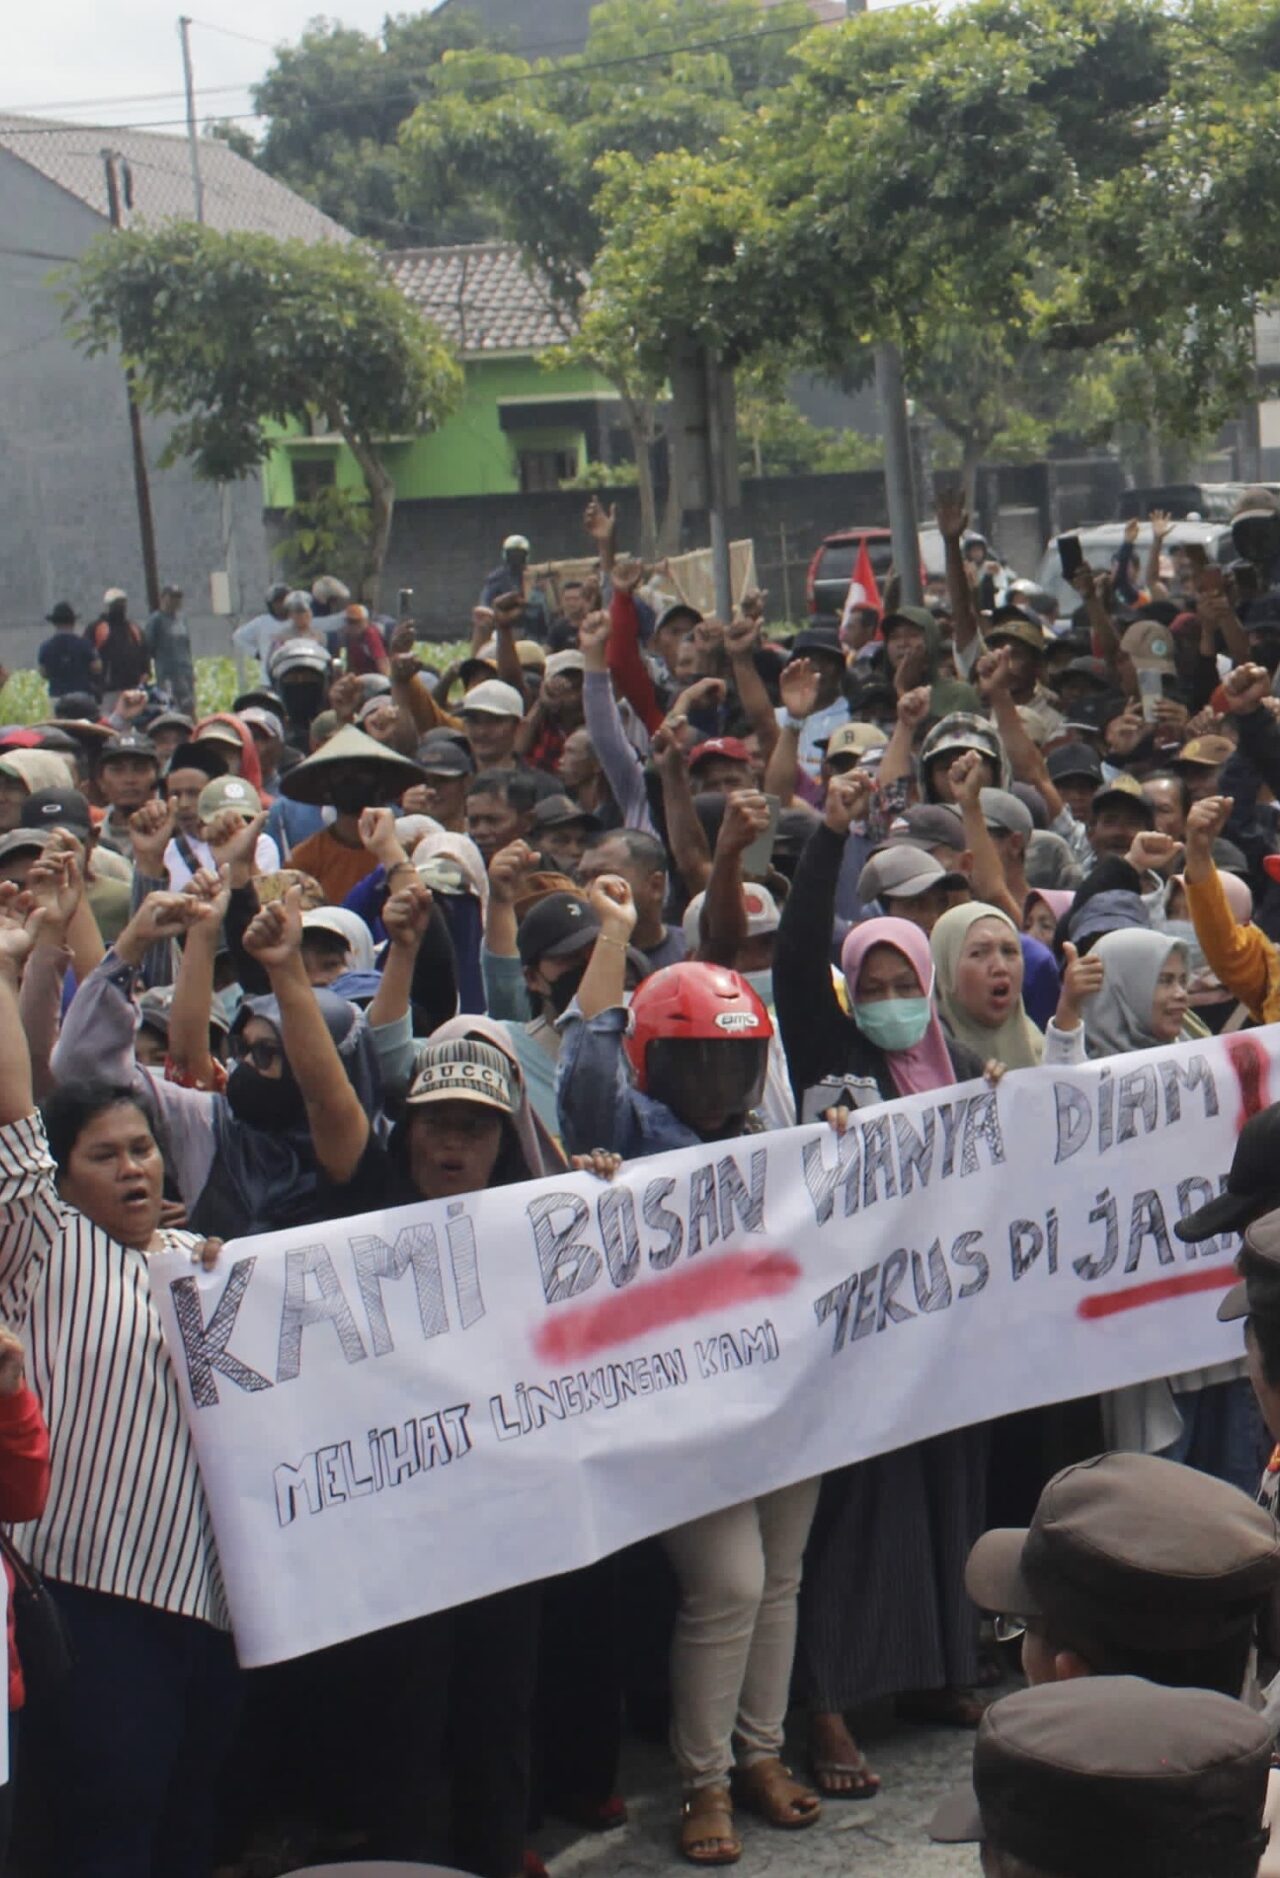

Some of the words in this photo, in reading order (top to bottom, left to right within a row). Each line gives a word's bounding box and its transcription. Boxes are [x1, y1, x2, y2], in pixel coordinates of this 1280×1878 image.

[422, 1064, 503, 1091] GUCCI
[527, 1147, 767, 1304] BOSAN
[813, 1230, 991, 1357] TERUS
